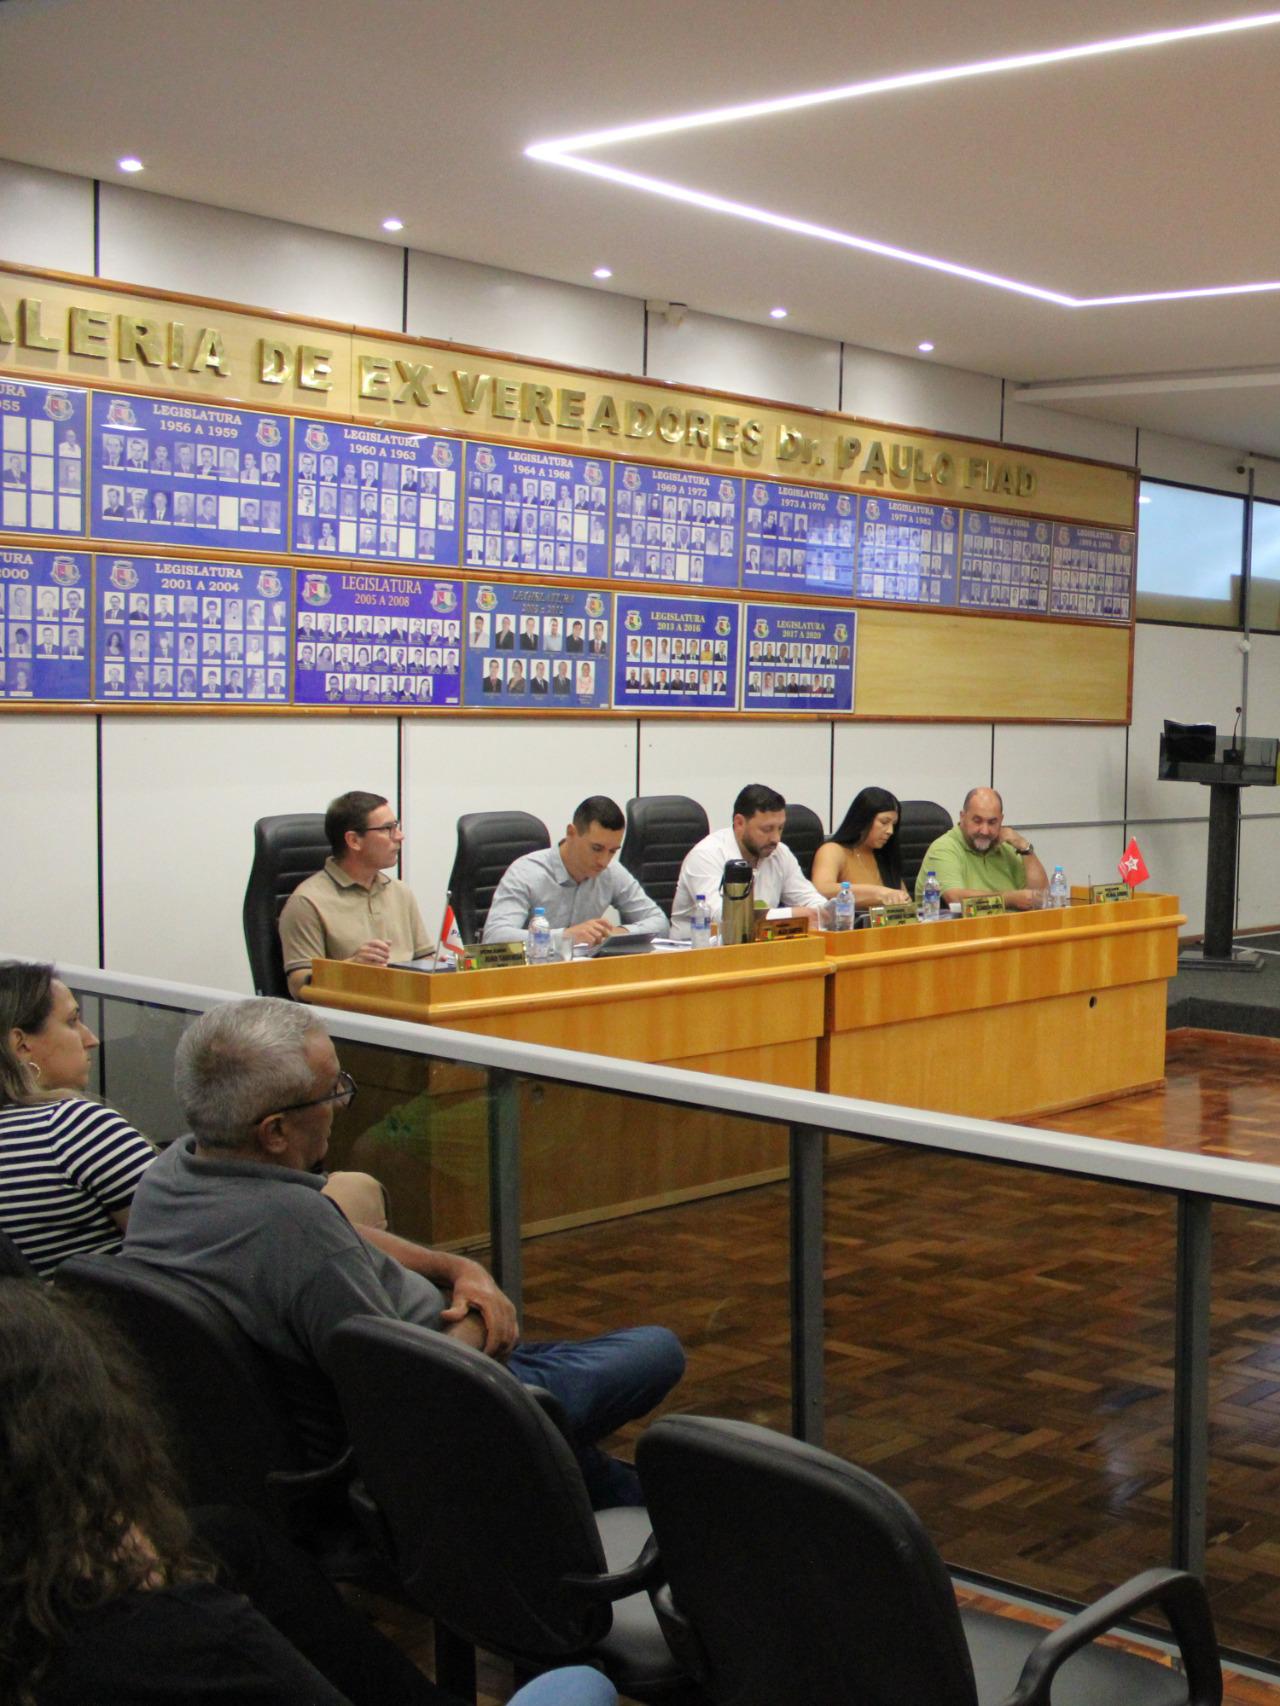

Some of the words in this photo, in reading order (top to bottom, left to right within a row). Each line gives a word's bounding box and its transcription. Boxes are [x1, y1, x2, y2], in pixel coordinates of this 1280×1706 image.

[0, 399, 20, 412] 55
[153, 403, 242, 426] LEGISLATURA
[258, 338, 334, 393] DE
[358, 354, 764, 457] EX-VEREADORES
[776, 423, 825, 466] Dr.
[835, 435, 955, 485] PAULO
[962, 456, 1038, 498] FIAD
[160, 419, 191, 434] 1956
[195, 423, 206, 435] A
[208, 424, 239, 439] 1959
[343, 428, 420, 448] LEGISLATURA
[349, 443, 377, 456] 1960
[379, 447, 389, 458] A
[391, 447, 416, 461] 1963
[508, 450, 574, 469] LEGISLATURA
[512, 464, 536, 477] 1964
[538, 467, 547, 477] A
[548, 468, 571, 480] 1968
[652, 470, 711, 487] LEGISLATURA
[656, 482, 677, 493] 1969
[678, 485, 686, 494] A
[687, 485, 708, 497] 1972
[778, 486, 829, 502] LEGISLATURA
[0, 567, 29, 580] 000
[156, 562, 243, 579] LEGISLATURA
[161, 578, 192, 591] 2001
[196, 580, 206, 591] A
[209, 580, 240, 593] 2004
[342, 575, 422, 595] LEGISLATURA
[354, 594, 377, 606] 2005
[378, 596, 387, 606] A
[650, 611, 706, 625] LEGISLATURA
[776, 620, 826, 632] LEGISLATURA
